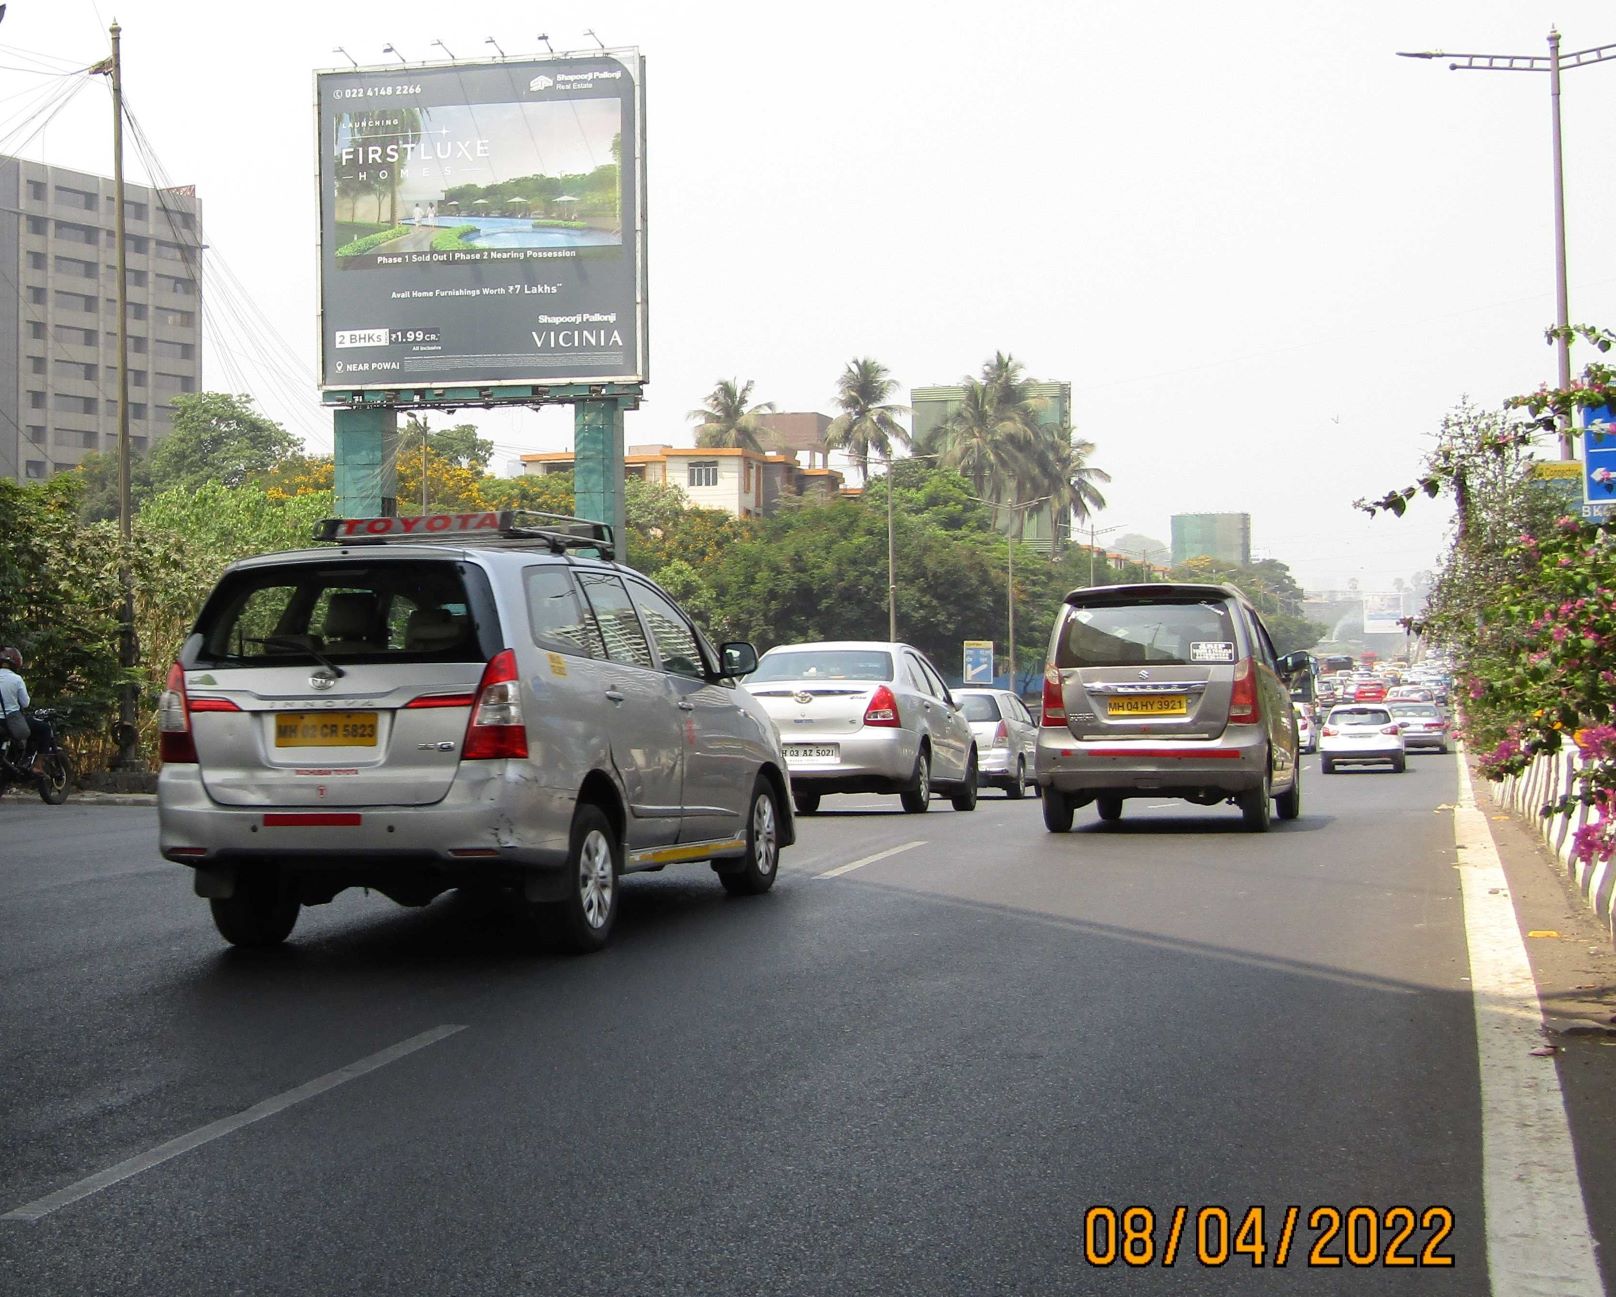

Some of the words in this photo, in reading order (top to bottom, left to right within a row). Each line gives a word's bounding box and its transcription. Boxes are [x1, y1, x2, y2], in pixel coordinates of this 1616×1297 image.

[556, 72, 594, 82] Shapoorji
[593, 70, 622, 79] Pallonji
[345, 88, 364, 98] 022
[366, 86, 393, 97] 4148
[395, 84, 422, 95] 2266
[572, 82, 593, 90] Estate
[342, 118, 399, 129] LAUNCHING
[341, 140, 489, 166] FIRSTLUXE
[358, 167, 453, 181] HOMES
[377, 256, 402, 264] Phase
[405, 255, 409, 263] 1
[411, 254, 430, 262] Sold
[432, 253, 447, 261] Out
[454, 252, 480, 260] Phase
[490, 251, 524, 260] Nearing
[526, 250, 576, 258] Possession
[435, 288, 480, 297] Furnishings
[482, 287, 506, 295] Worth
[538, 313, 582, 324] Shapoorji
[582, 312, 617, 323] Pallonji
[338, 335, 345, 345] 2
[349, 333, 382, 344] BHKs
[531, 329, 623, 348] VICINIA
[346, 363, 369, 372] NEAR
[371, 362, 400, 370] POWAI
[343, 512, 499, 535] TOYOTA
[1108, 701, 1124, 711] MH
[1126, 701, 1138, 711] 04
[1141, 700, 1154, 710] HY
[1157, 700, 1182, 710] 3921
[278, 724, 297, 738] MH
[321, 724, 338, 738] CR
[343, 724, 375, 738] 5823
[789, 749, 799, 757] 03
[802, 749, 813, 757] AZ
[816, 749, 834, 757] 5021
